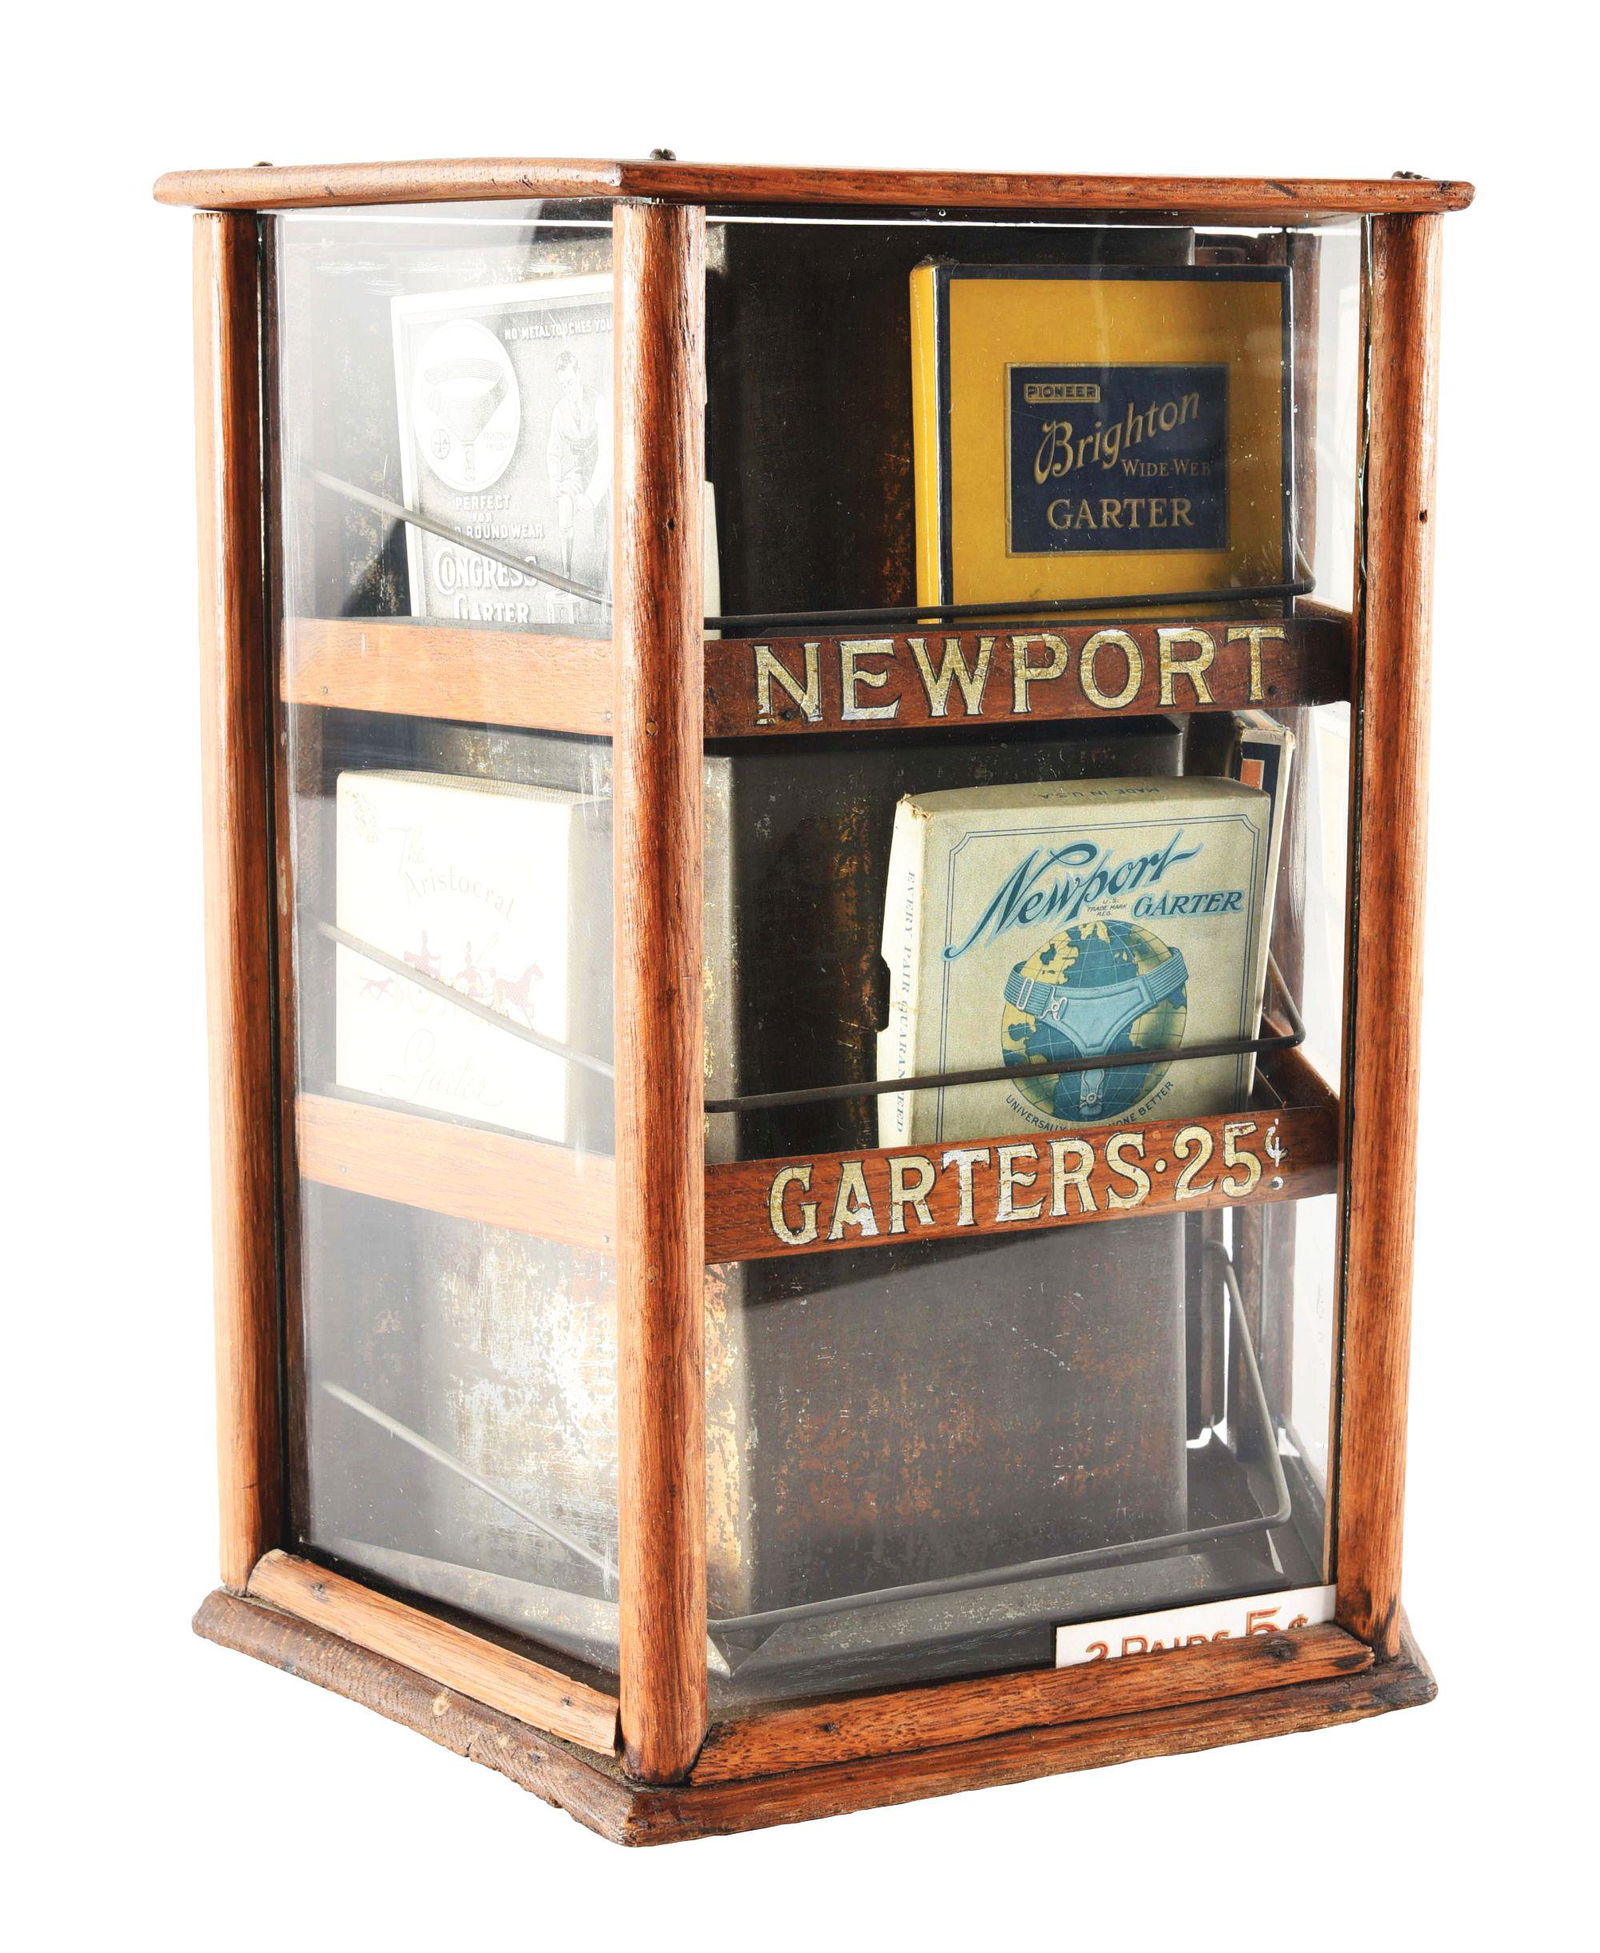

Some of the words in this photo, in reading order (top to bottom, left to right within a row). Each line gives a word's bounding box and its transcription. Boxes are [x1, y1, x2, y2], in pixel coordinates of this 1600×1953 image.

[504, 327, 518, 340] NO
[520, 324, 549, 339] METAL
[548, 320, 593, 337] TOUCHES
[1027, 385, 1096, 399] PIONEER
[1033, 391, 1201, 485] Brighton
[455, 494, 511, 512] PERFECT
[1046, 498, 1194, 530] GARTER
[510, 522, 545, 539] WEAR
[454, 593, 530, 624] GARTER
[753, 626, 1288, 726] NEWPORT
[904, 870, 915, 938] EVERY
[943, 829, 1204, 961] Newport
[1132, 889, 1244, 919] GARTER
[901, 946, 912, 993] PAIR
[895, 1000, 909, 1134] GUARANEED
[1138, 1082, 1174, 1117] BETTER
